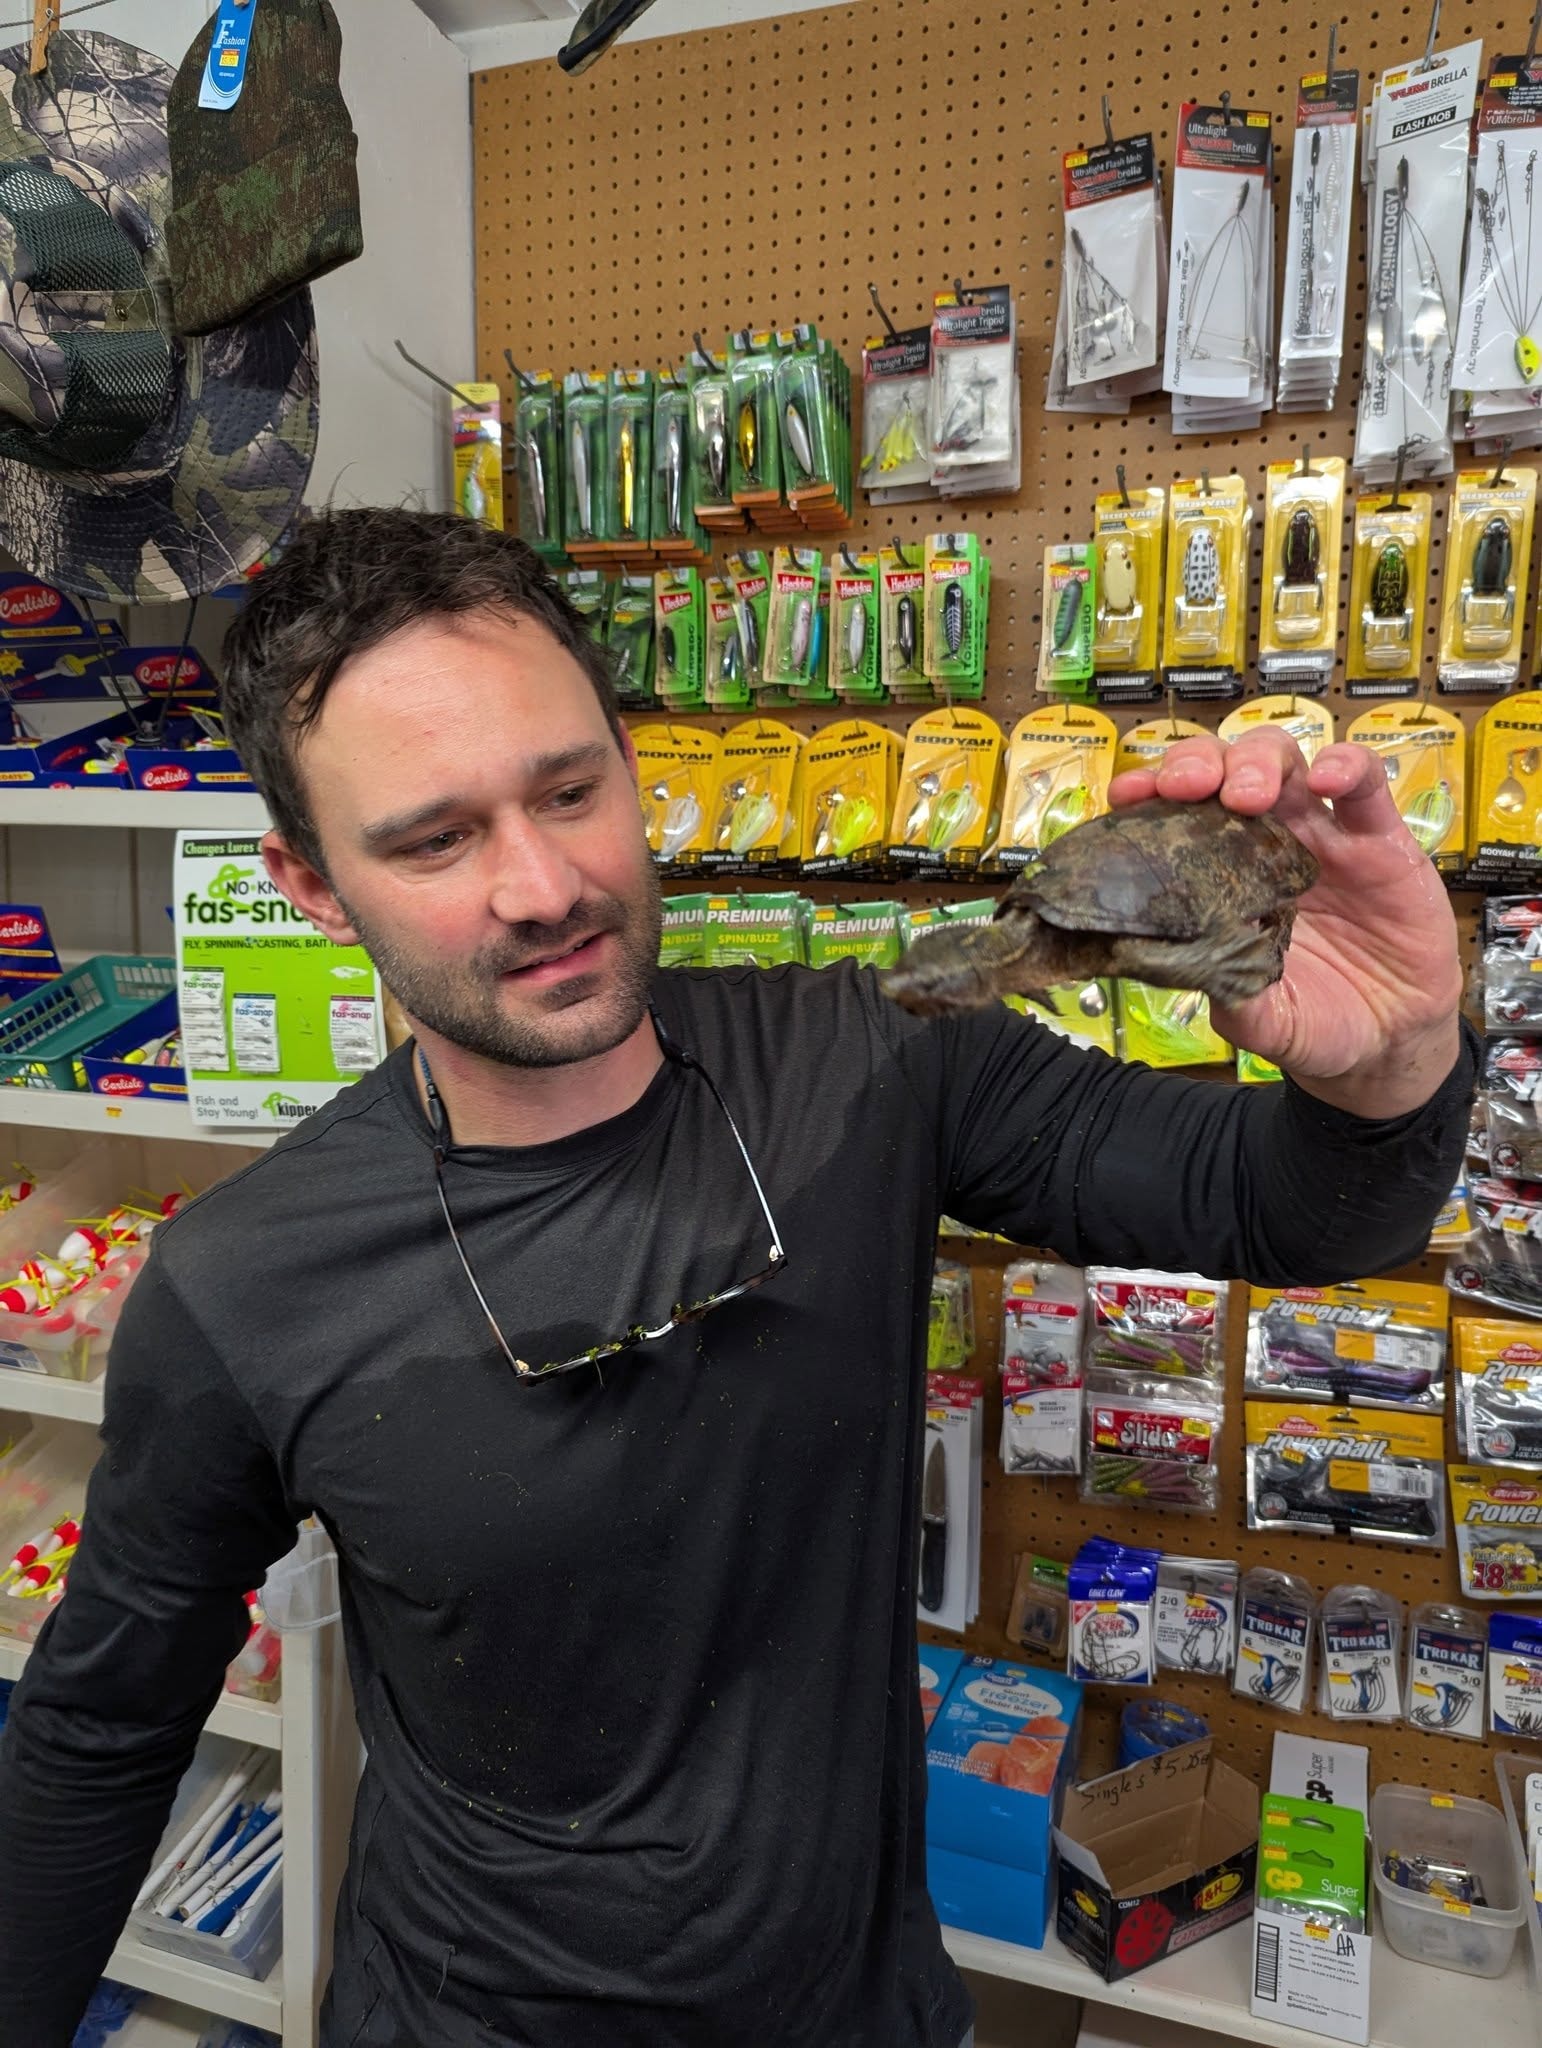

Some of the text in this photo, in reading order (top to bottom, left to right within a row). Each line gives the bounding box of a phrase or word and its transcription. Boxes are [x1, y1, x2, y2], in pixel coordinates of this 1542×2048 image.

[212, 20, 246, 48] Fashion
[1431, 67, 1468, 88] BRELLA
[1188, 123, 1227, 138] Ultralight
[1395, 111, 1453, 136] FLASH MOB
[1072, 154, 1142, 179] Ultralight Flash Mob
[1379, 190, 1399, 298] TECHNOLOGY
[938, 315, 1006, 332] Ultralight Tripod
[1466, 296, 1487, 376] Technology
[740, 579, 768, 599] Heddon
[781, 576, 815, 592] Heddon
[840, 581, 873, 598] Heddon
[889, 575, 924, 594] Heddon
[0, 590, 58, 618] Carlisle
[663, 593, 692, 614] Heddon
[964, 598, 973, 670] TORPEDO
[1082, 604, 1092, 674] TORPEDO
[687, 625, 695, 687] TORPEDO
[866, 615, 875, 686] TORPEDO
[1266, 657, 1328, 668] TOADRUNNER
[140, 660, 198, 684] Carlsle
[1169, 673, 1228, 683] TOADRUNNER
[1097, 677, 1149, 687] TOADRUNNER
[1351, 684, 1412, 695] TOADRUNNER
[1494, 720, 1542, 731] BOO
[914, 735, 994, 747] BOOYAH
[1021, 733, 1108, 745] BOOYAH
[1352, 731, 1456, 742] BOOYAH
[637, 750, 713, 761] BOOYAH
[724, 745, 792, 757] BOOYAH
[809, 741, 881, 762] BOOYAH
[144, 769, 189, 786] Carlisle
[185, 841, 254, 856] Changes Lures
[1481, 847, 1514, 857] BOOYAH
[227, 881, 280, 895] NO KN
[184, 893, 313, 928] fas-sna
[707, 909, 790, 923] PREMIUM
[0, 919, 41, 937] arlisle
[812, 917, 896, 936] PREMIUM
[185, 940, 201, 950] FLY,
[256, 939, 302, 950] CASTING,
[306, 938, 329, 948] BAIT
[662, 933, 704, 945] N/BUZZ
[718, 933, 780, 945] SPIN/BUZZ
[824, 941, 887, 956] SPIN/BUZZ
[184, 980, 222, 991] fas-snap
[236, 1007, 273, 1018] fas-snap
[332, 1009, 372, 1021] fas-snap
[100, 1074, 143, 1091] Carlisle
[195, 1096, 239, 1106] Fish and
[197, 1108, 259, 1120] Stay Young!
[277, 1103, 318, 1118] kipper
[1286, 1288, 1320, 1299] Berkley
[1041, 1304, 1058, 1313] CLAW
[1266, 1297, 1393, 1325] PowerBait
[1264, 1433, 1389, 1461] PowerBait
[1494, 1488, 1536, 1500] Berkley
[1088, 1588, 1126, 1598] EAGLE CLAW
[1160, 1595, 1178, 1606] 2/0
[1159, 1611, 1166, 1620] 6
[1184, 1609, 1218, 1619] LAZER
[1187, 1617, 1218, 1626] SHARP
[1244, 1638, 1303, 1662] 6 2/0
[974, 1656, 993, 1665] 50
[1332, 1658, 1340, 1668] 6
[1371, 1656, 1391, 1666] 2/0
[1420, 1666, 1481, 1688] 6 3/0
[979, 1687, 1049, 1710] Freezer
[1307, 1752, 1323, 1779] Super
[1081, 1773, 1145, 1810] Singles
[1265, 1866, 1304, 1892] GP
[1321, 1878, 1360, 1898] Super
[1336, 1932, 1356, 1958] AA
